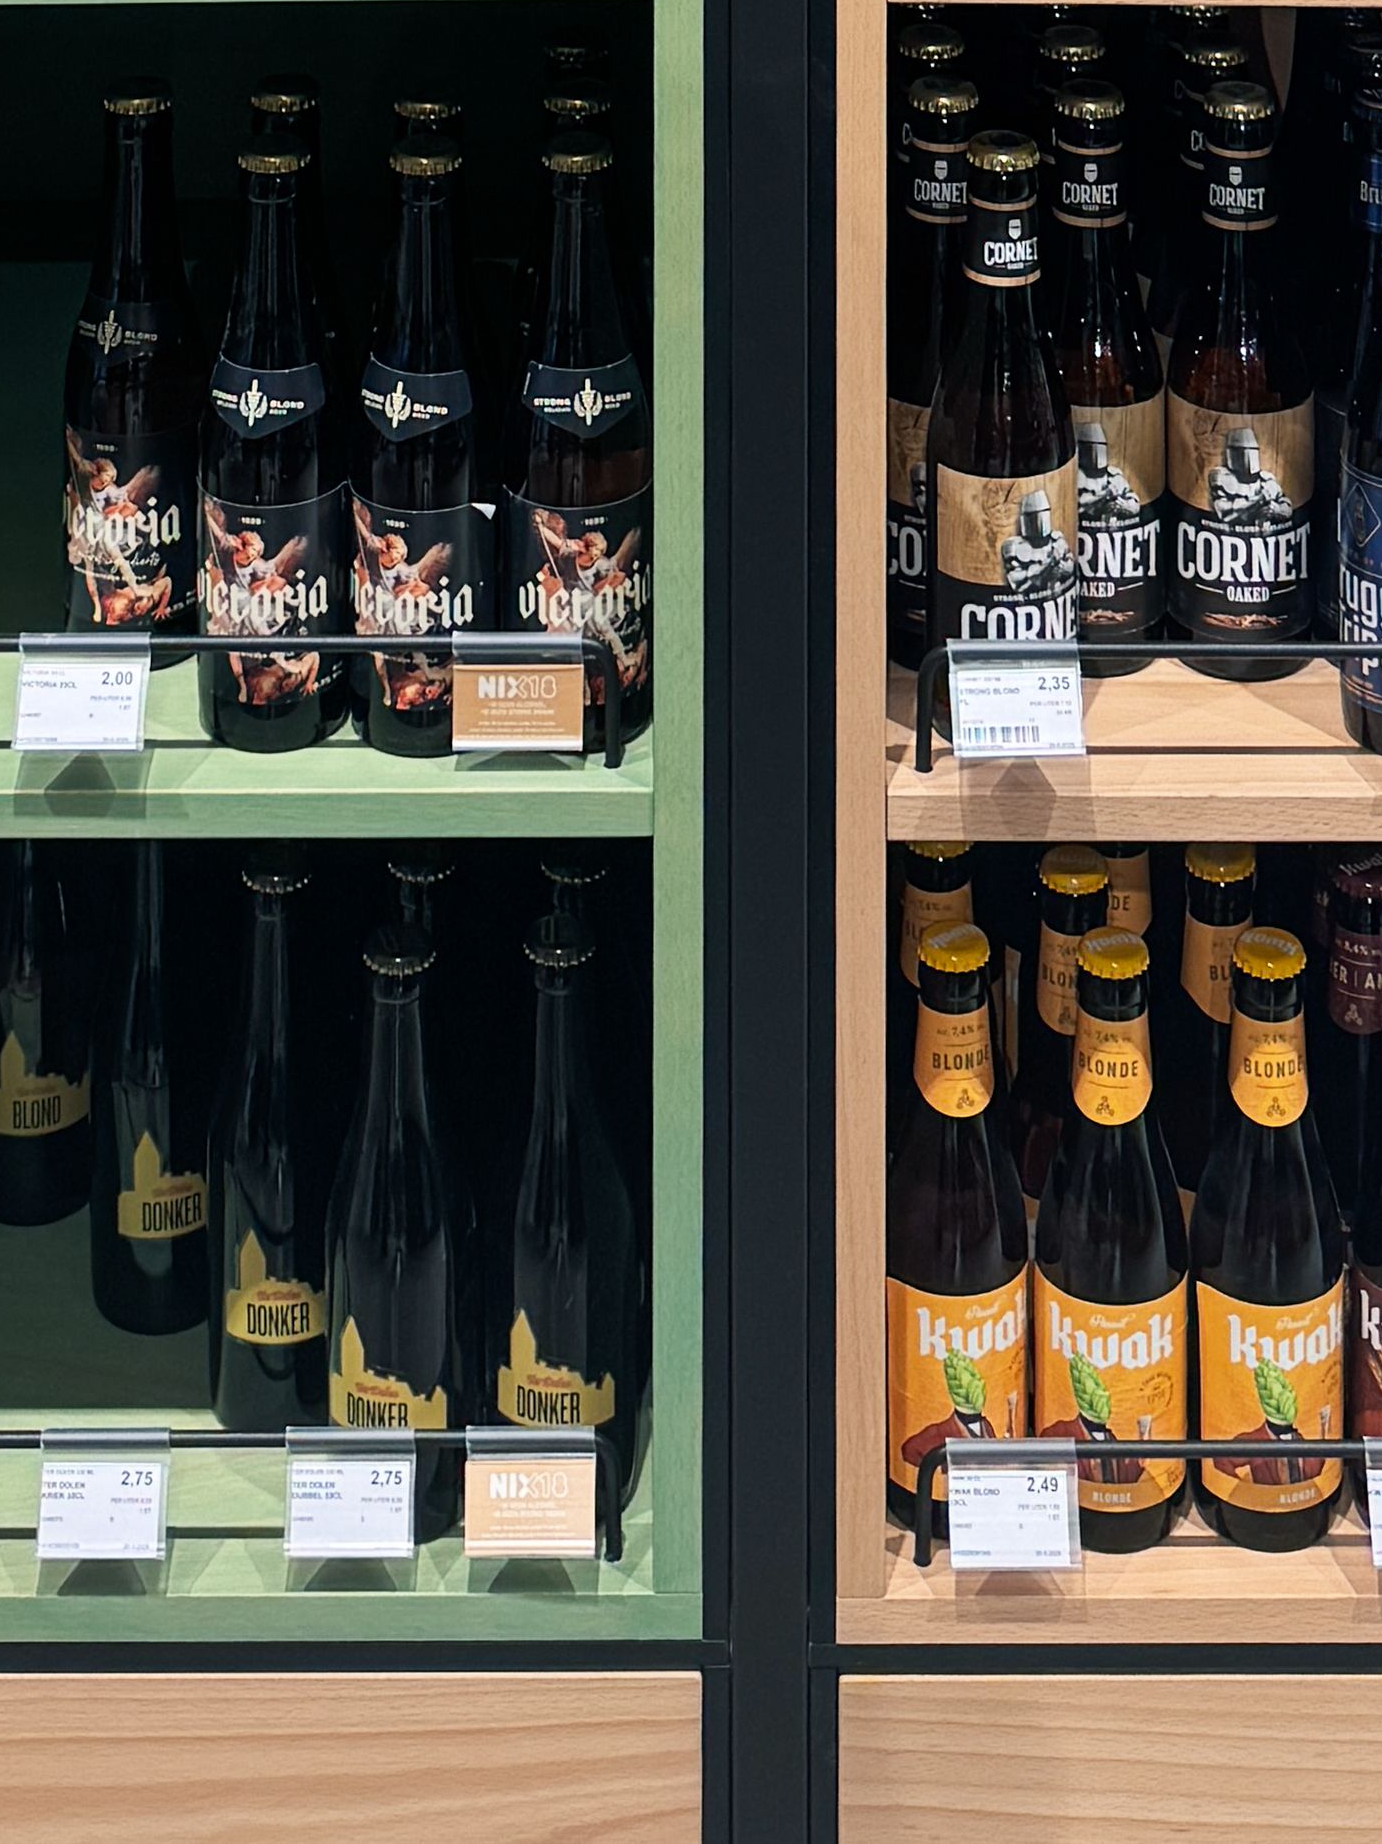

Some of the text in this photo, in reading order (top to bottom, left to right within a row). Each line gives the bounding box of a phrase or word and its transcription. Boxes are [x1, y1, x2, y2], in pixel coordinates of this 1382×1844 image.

[914, 178, 969, 206] CORNET
[1062, 177, 1118, 207] CORNET
[1209, 182, 1266, 212] CORNET
[983, 235, 1038, 267] CORNET
[1176, 520, 1311, 584] CORNET
[1226, 584, 1270, 604] OAKED
[101, 671, 134, 687] 2,00
[477, 674, 558, 699] NIX18
[1037, 675, 1070, 691] 2,35
[931, 1049, 990, 1073] BLONDE
[1078, 1057, 1140, 1079] BLONDE
[1242, 1053, 1305, 1078] BLONDE
[11, 1096, 63, 1131] BLOND
[140, 1191, 203, 1232] DONKER
[244, 1302, 310, 1338] DONKER
[1049, 1301, 1176, 1370] kwak
[515, 1384, 581, 1426] DONKER
[120, 1470, 153, 1488] 2,75
[370, 1470, 404, 1488] 2,75
[490, 1471, 570, 1499] NIX18
[1025, 1475, 1059, 1493] 2,49
